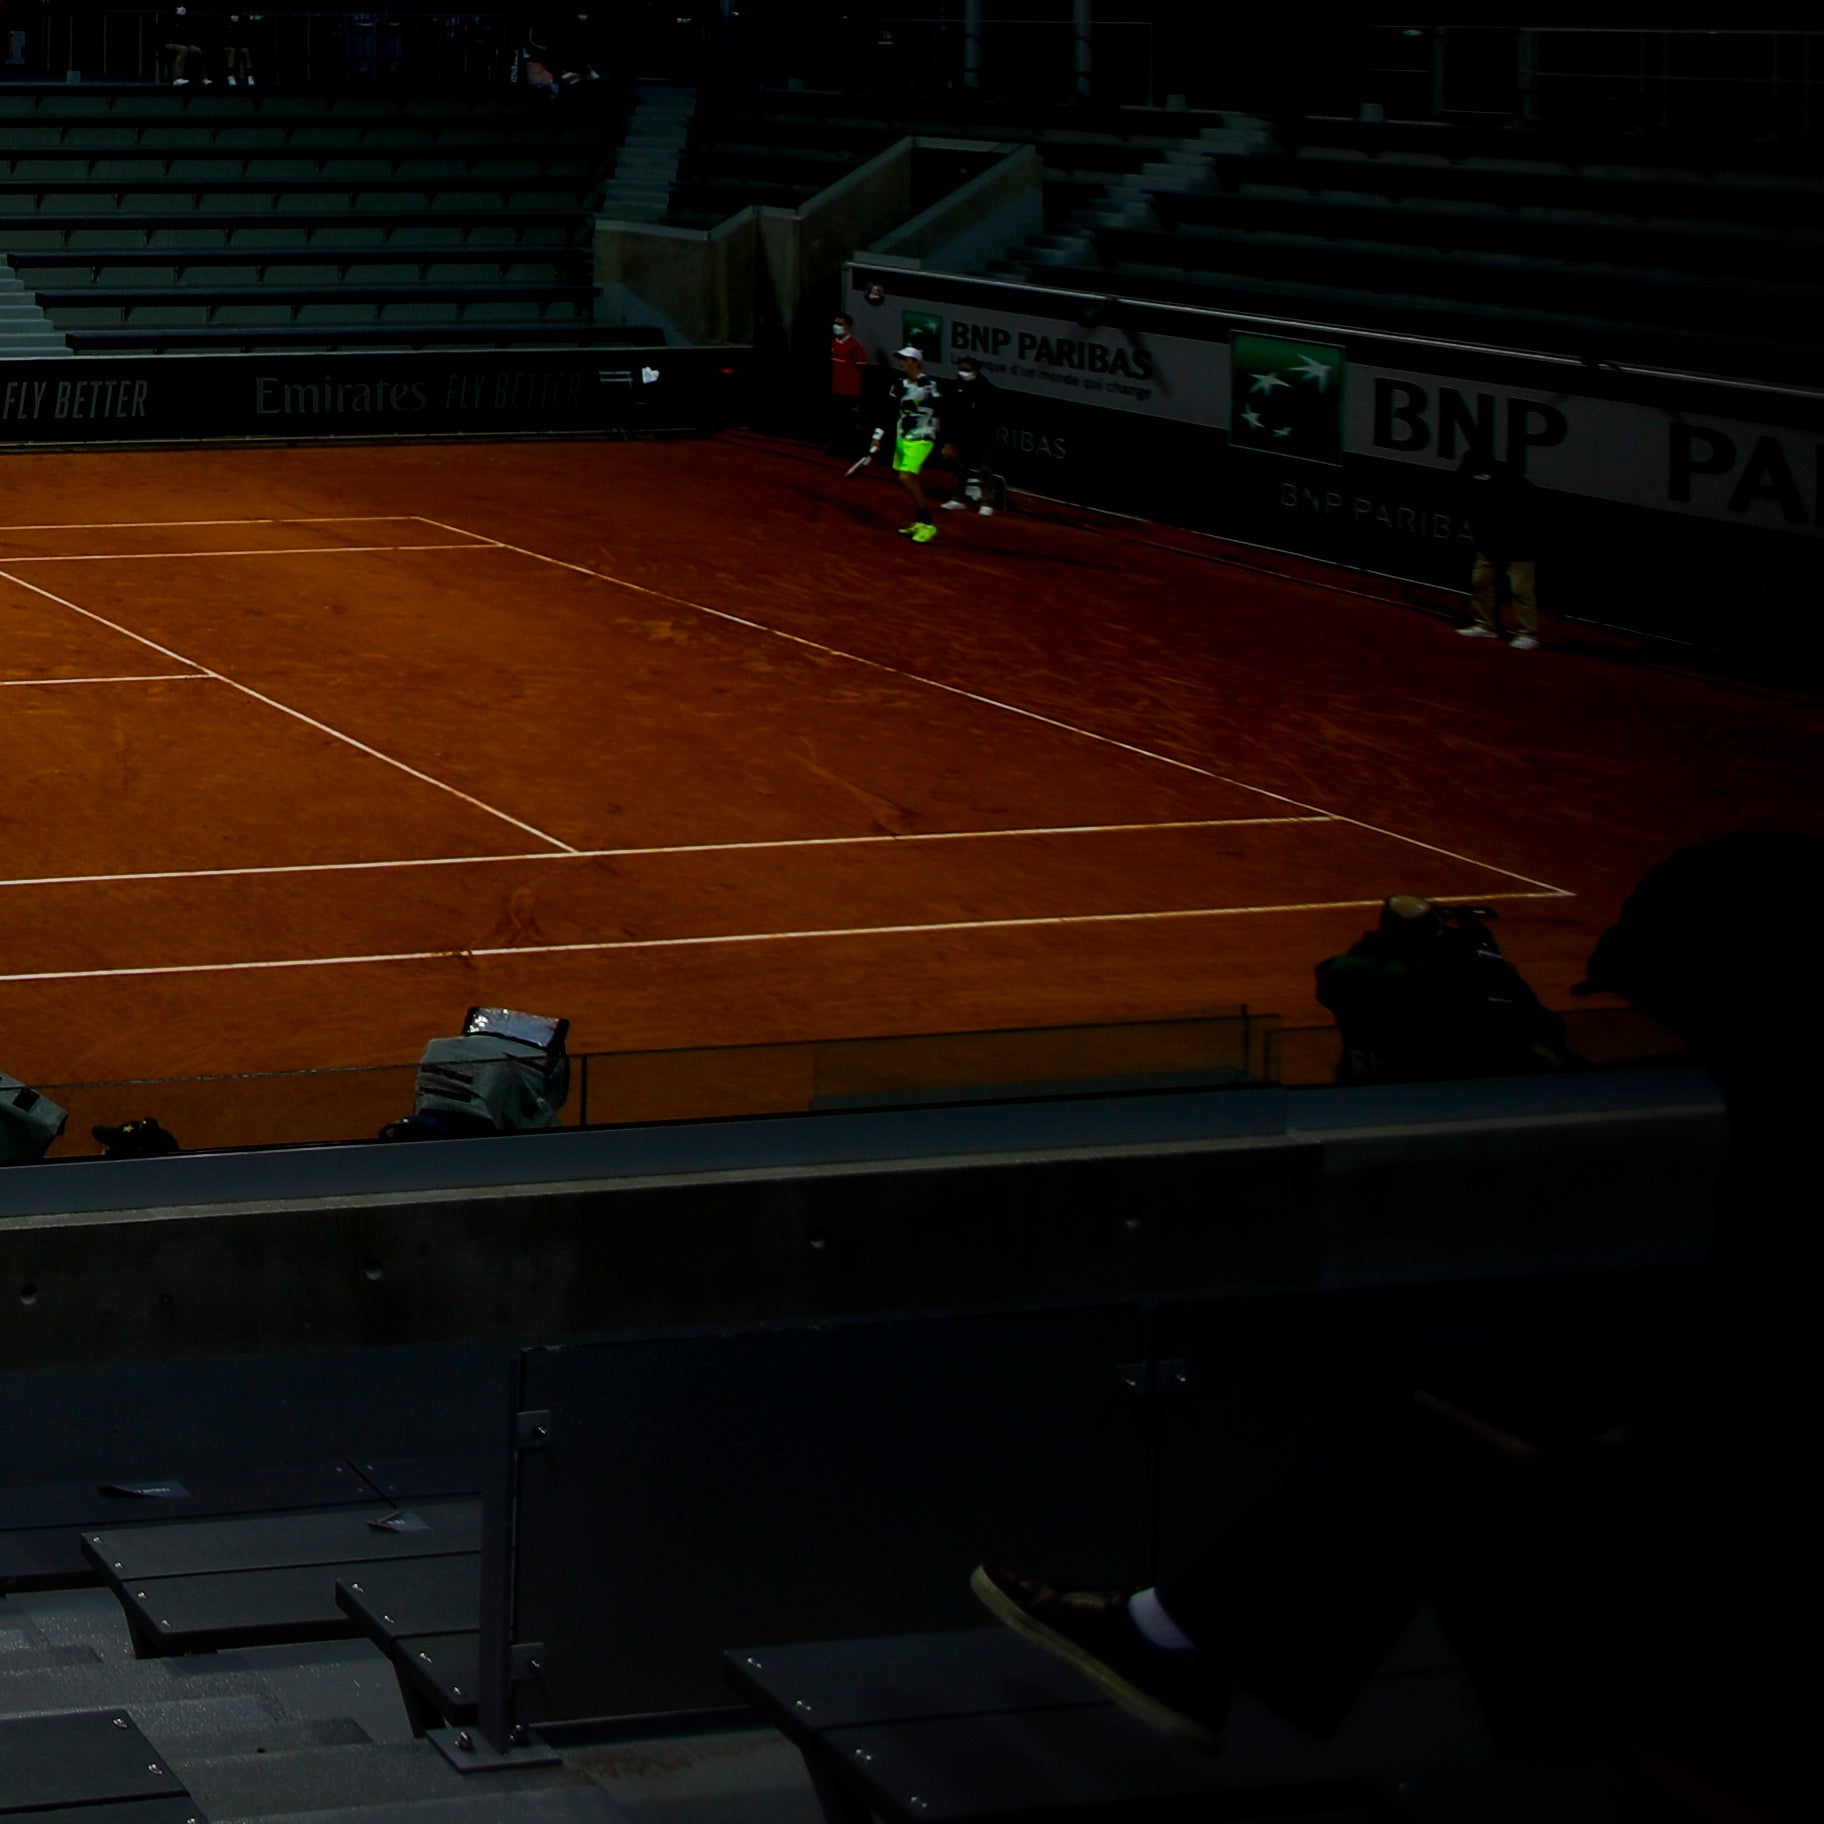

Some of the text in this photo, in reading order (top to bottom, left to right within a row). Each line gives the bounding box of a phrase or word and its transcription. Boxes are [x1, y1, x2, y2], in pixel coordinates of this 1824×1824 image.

[951, 320, 1153, 381] BNP PARIBAS
[2, 381, 49, 420] FLY
[54, 378, 149, 420] BETTER
[255, 371, 583, 416] Emirates FLY BETTER
[995, 425, 1067, 460] RIBAS
[1373, 376, 1824, 524] BNP PA
[1279, 482, 1477, 545] BNP PARIBA
